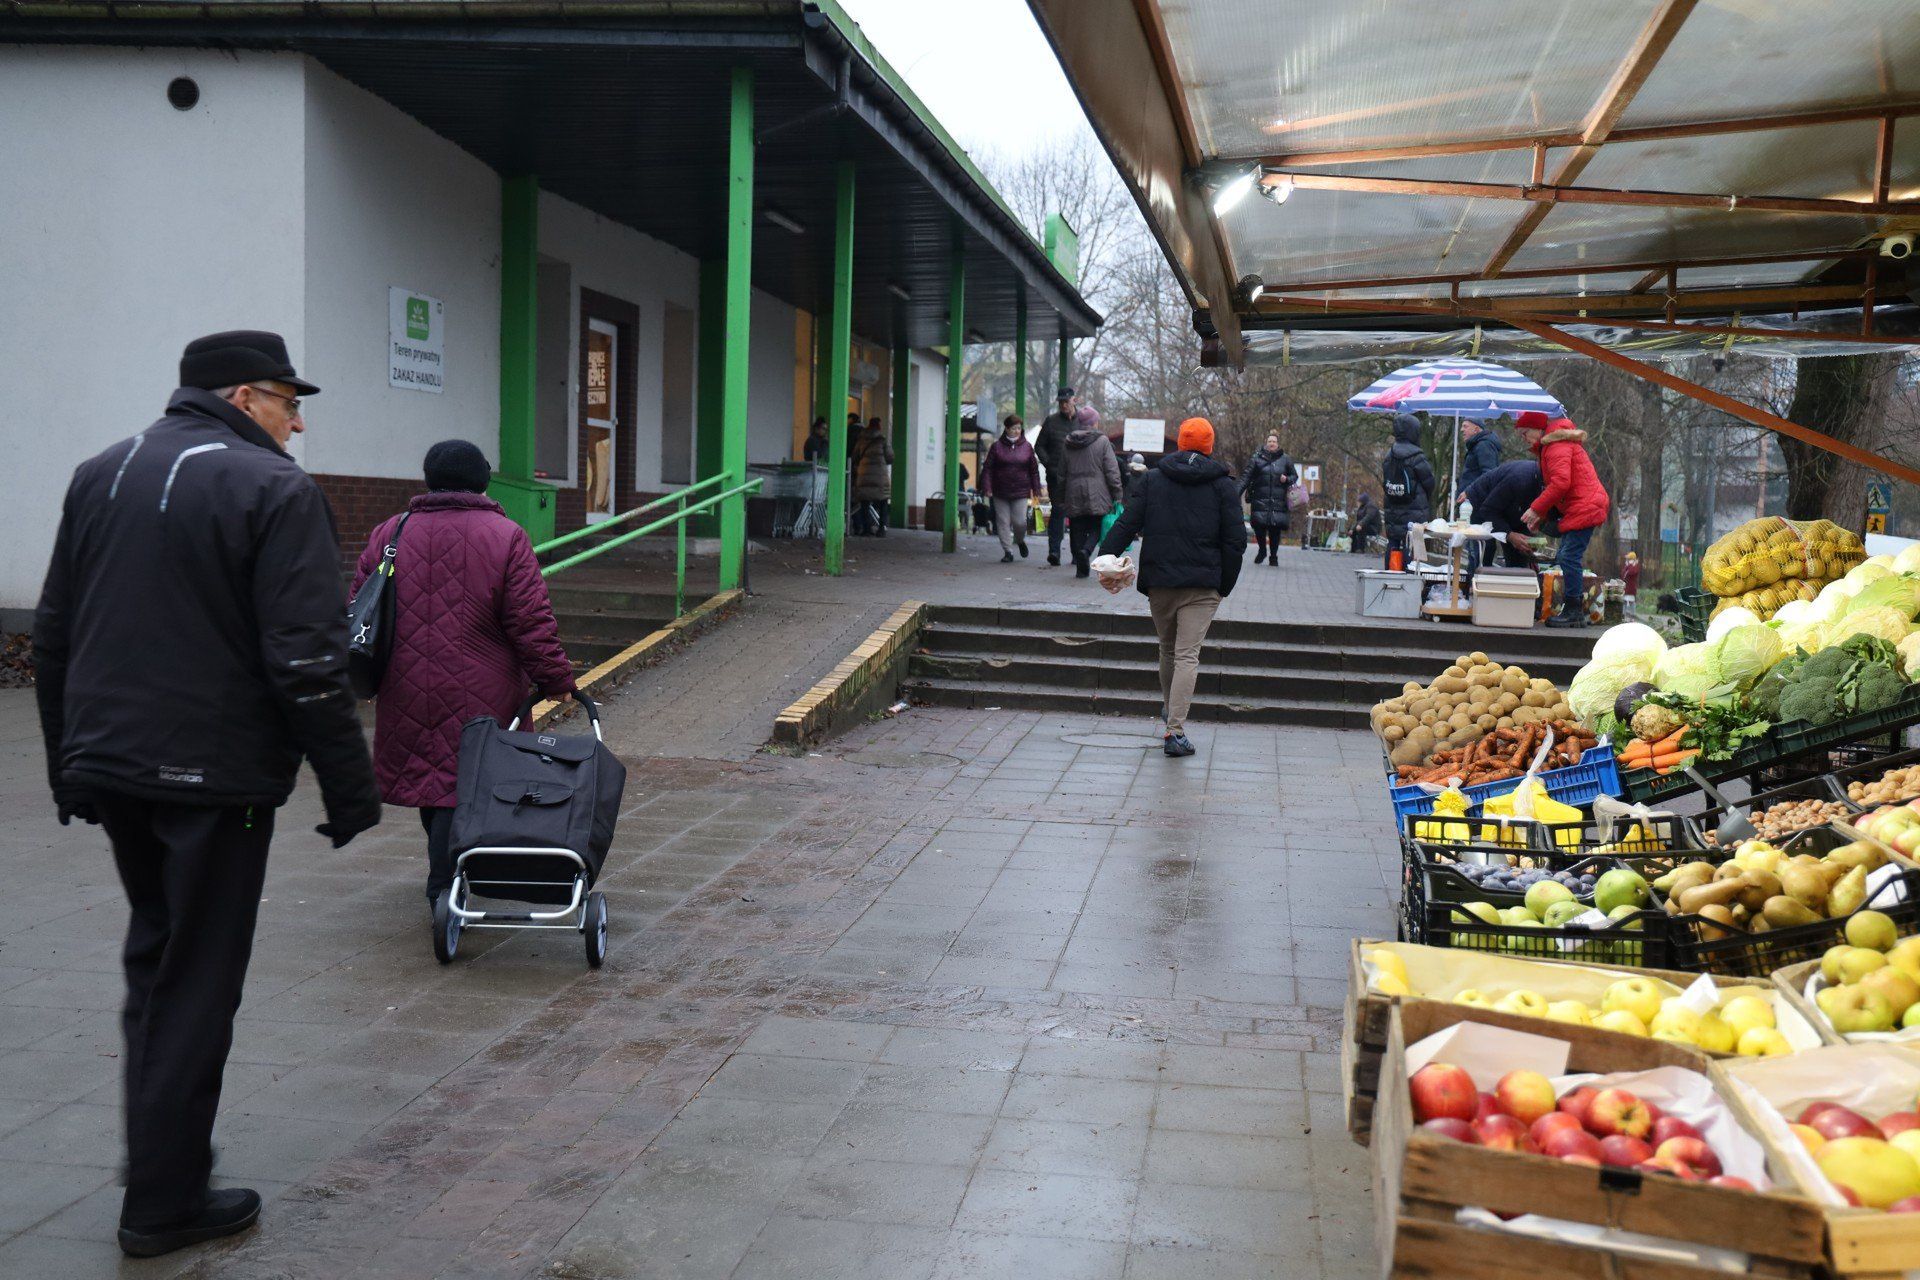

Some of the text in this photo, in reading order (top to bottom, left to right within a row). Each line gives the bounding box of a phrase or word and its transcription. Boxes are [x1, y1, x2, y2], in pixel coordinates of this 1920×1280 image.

[394, 342, 440, 366] Teren prywatny
[393, 367, 442, 387] ZAKAZ HANDLU
